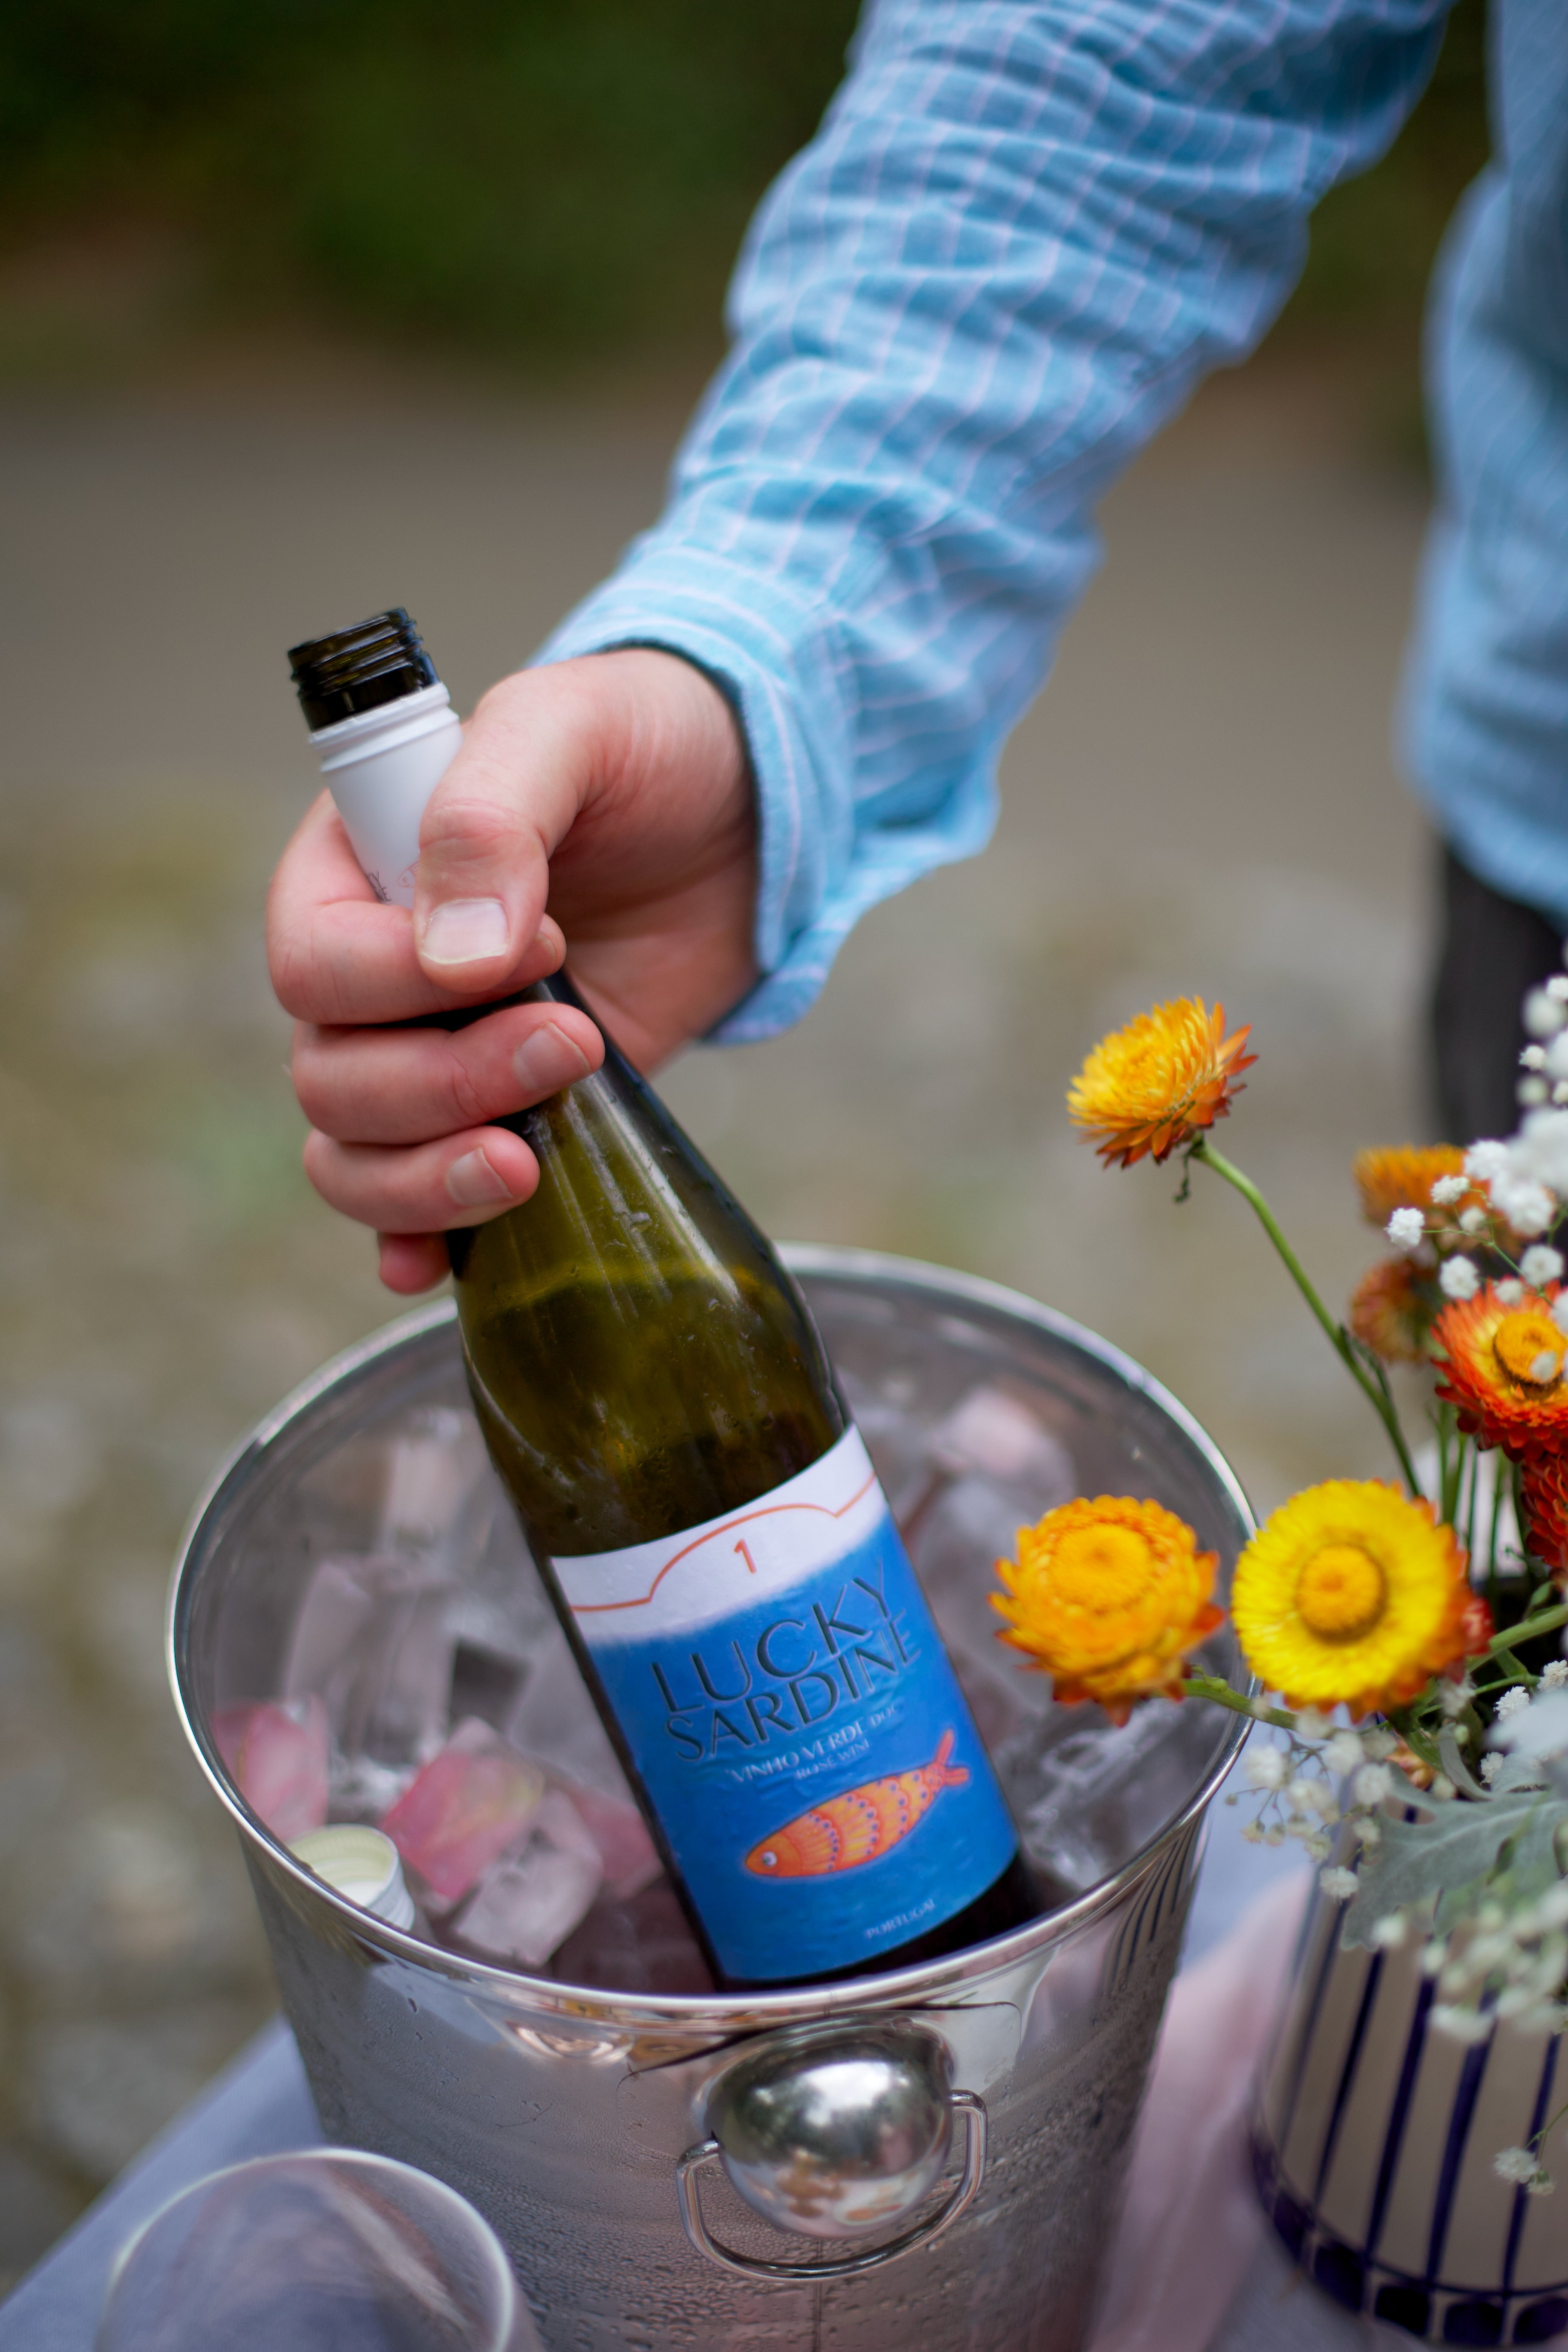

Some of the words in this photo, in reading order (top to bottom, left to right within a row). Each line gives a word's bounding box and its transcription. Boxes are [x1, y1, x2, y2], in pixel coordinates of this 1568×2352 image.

[734, 1538, 758, 1574] 1
[650, 1556, 892, 1714] LUCKY
[666, 1608, 922, 1762] SARDINE
[725, 1751, 799, 1783] VINHO
